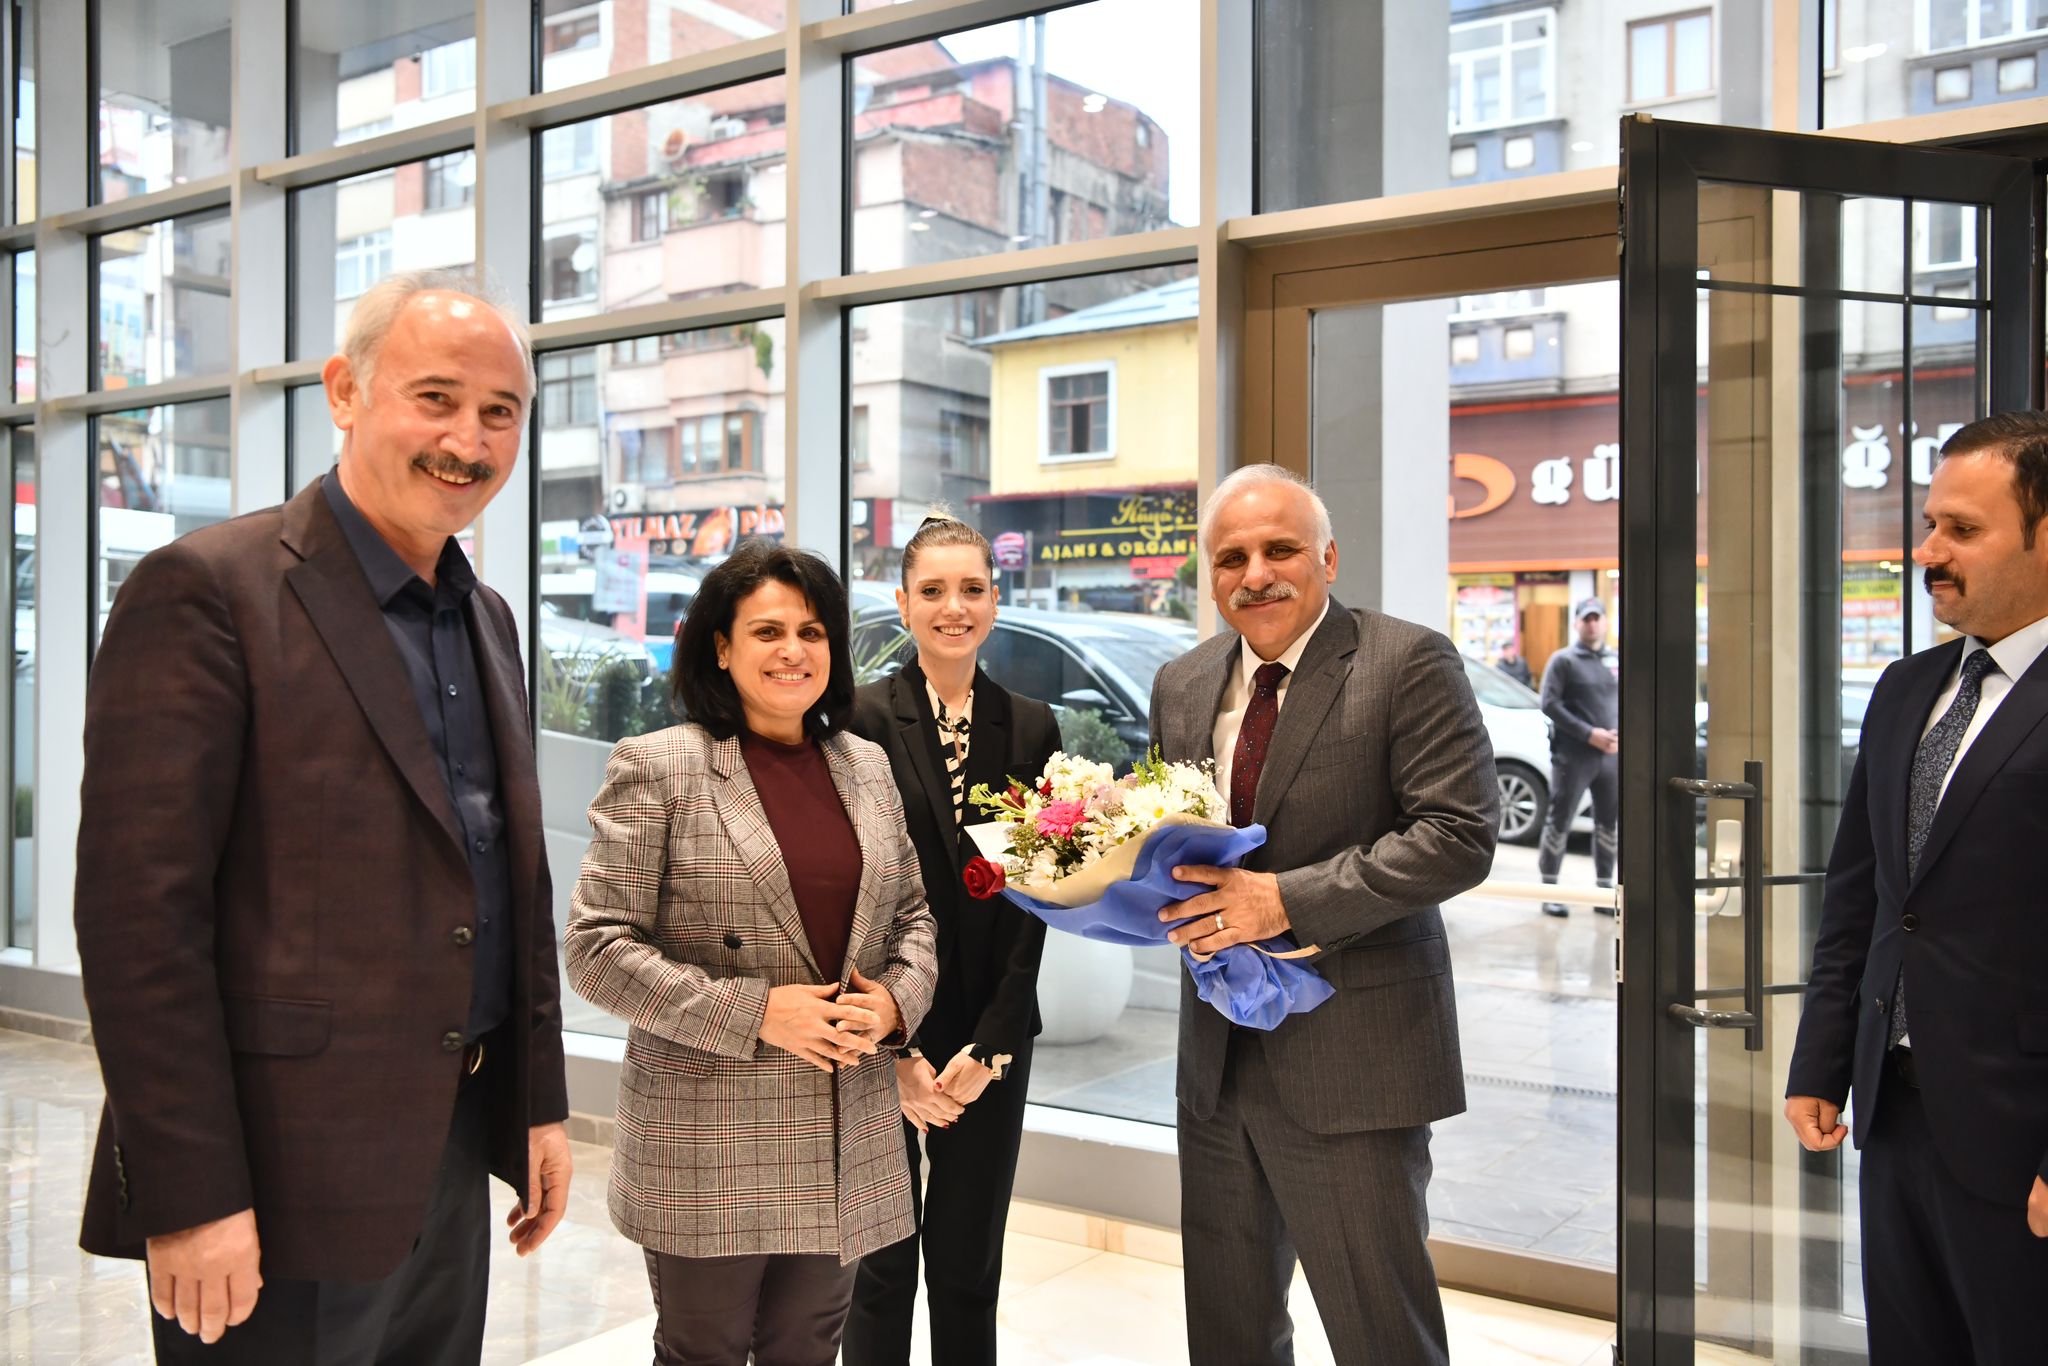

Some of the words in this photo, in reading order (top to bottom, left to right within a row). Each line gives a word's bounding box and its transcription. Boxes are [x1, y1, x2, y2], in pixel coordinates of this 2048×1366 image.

[610, 512, 698, 541] YILMAZ
[740, 502, 785, 536] PİD
[1041, 542, 1098, 561] AJANS
[1101, 542, 1115, 557] &
[1118, 535, 1197, 556] ORGANİ
